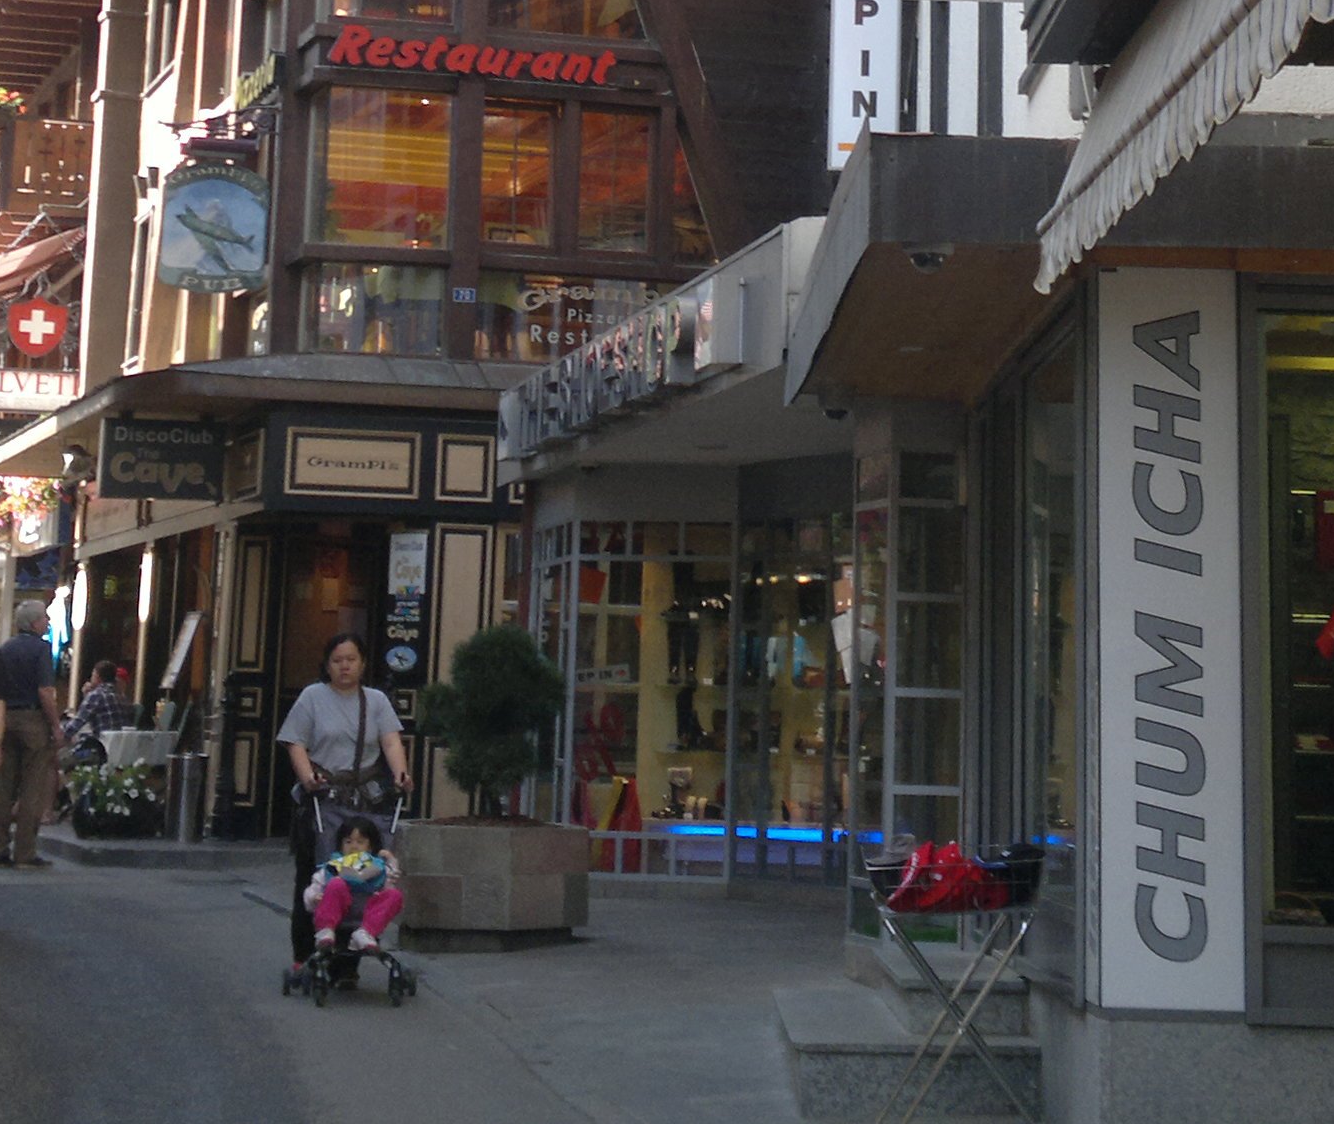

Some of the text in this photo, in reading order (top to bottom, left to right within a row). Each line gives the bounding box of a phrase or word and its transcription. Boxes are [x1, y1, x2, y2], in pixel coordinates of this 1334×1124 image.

[327, 24, 617, 85] Restaurant
[852, 48, 878, 119] IN
[179, 275, 244, 290] PUB
[109, 451, 206, 494] Cave
[1132, 310, 1208, 964] ICHA CHUM
